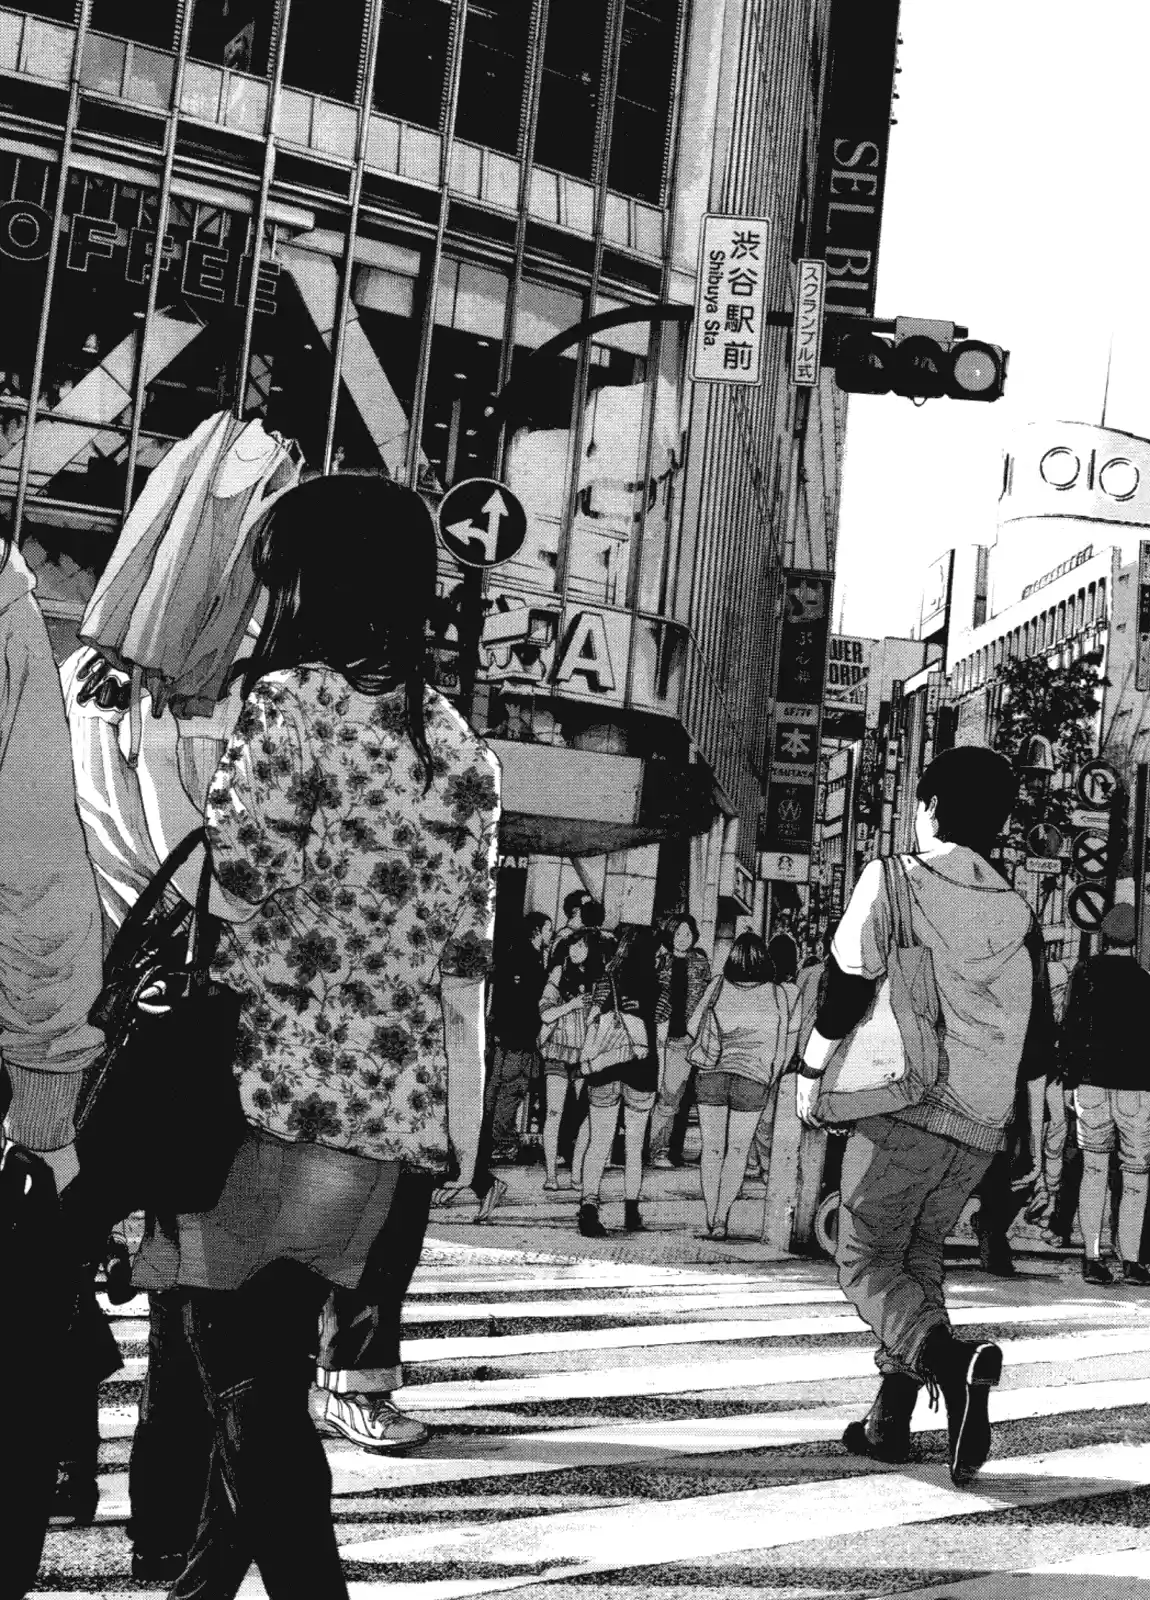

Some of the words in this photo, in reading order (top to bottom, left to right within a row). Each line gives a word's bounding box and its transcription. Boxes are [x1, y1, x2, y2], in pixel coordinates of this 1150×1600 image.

[0, 199, 282, 315] OFFEE
[704, 250, 726, 314] Shibuya
[723, 230, 761, 371] 渋谷駅前
[703, 319, 721, 351] Sta.
[798, 266, 819, 379] スクランブル式
[780, 728, 811, 759] 本
